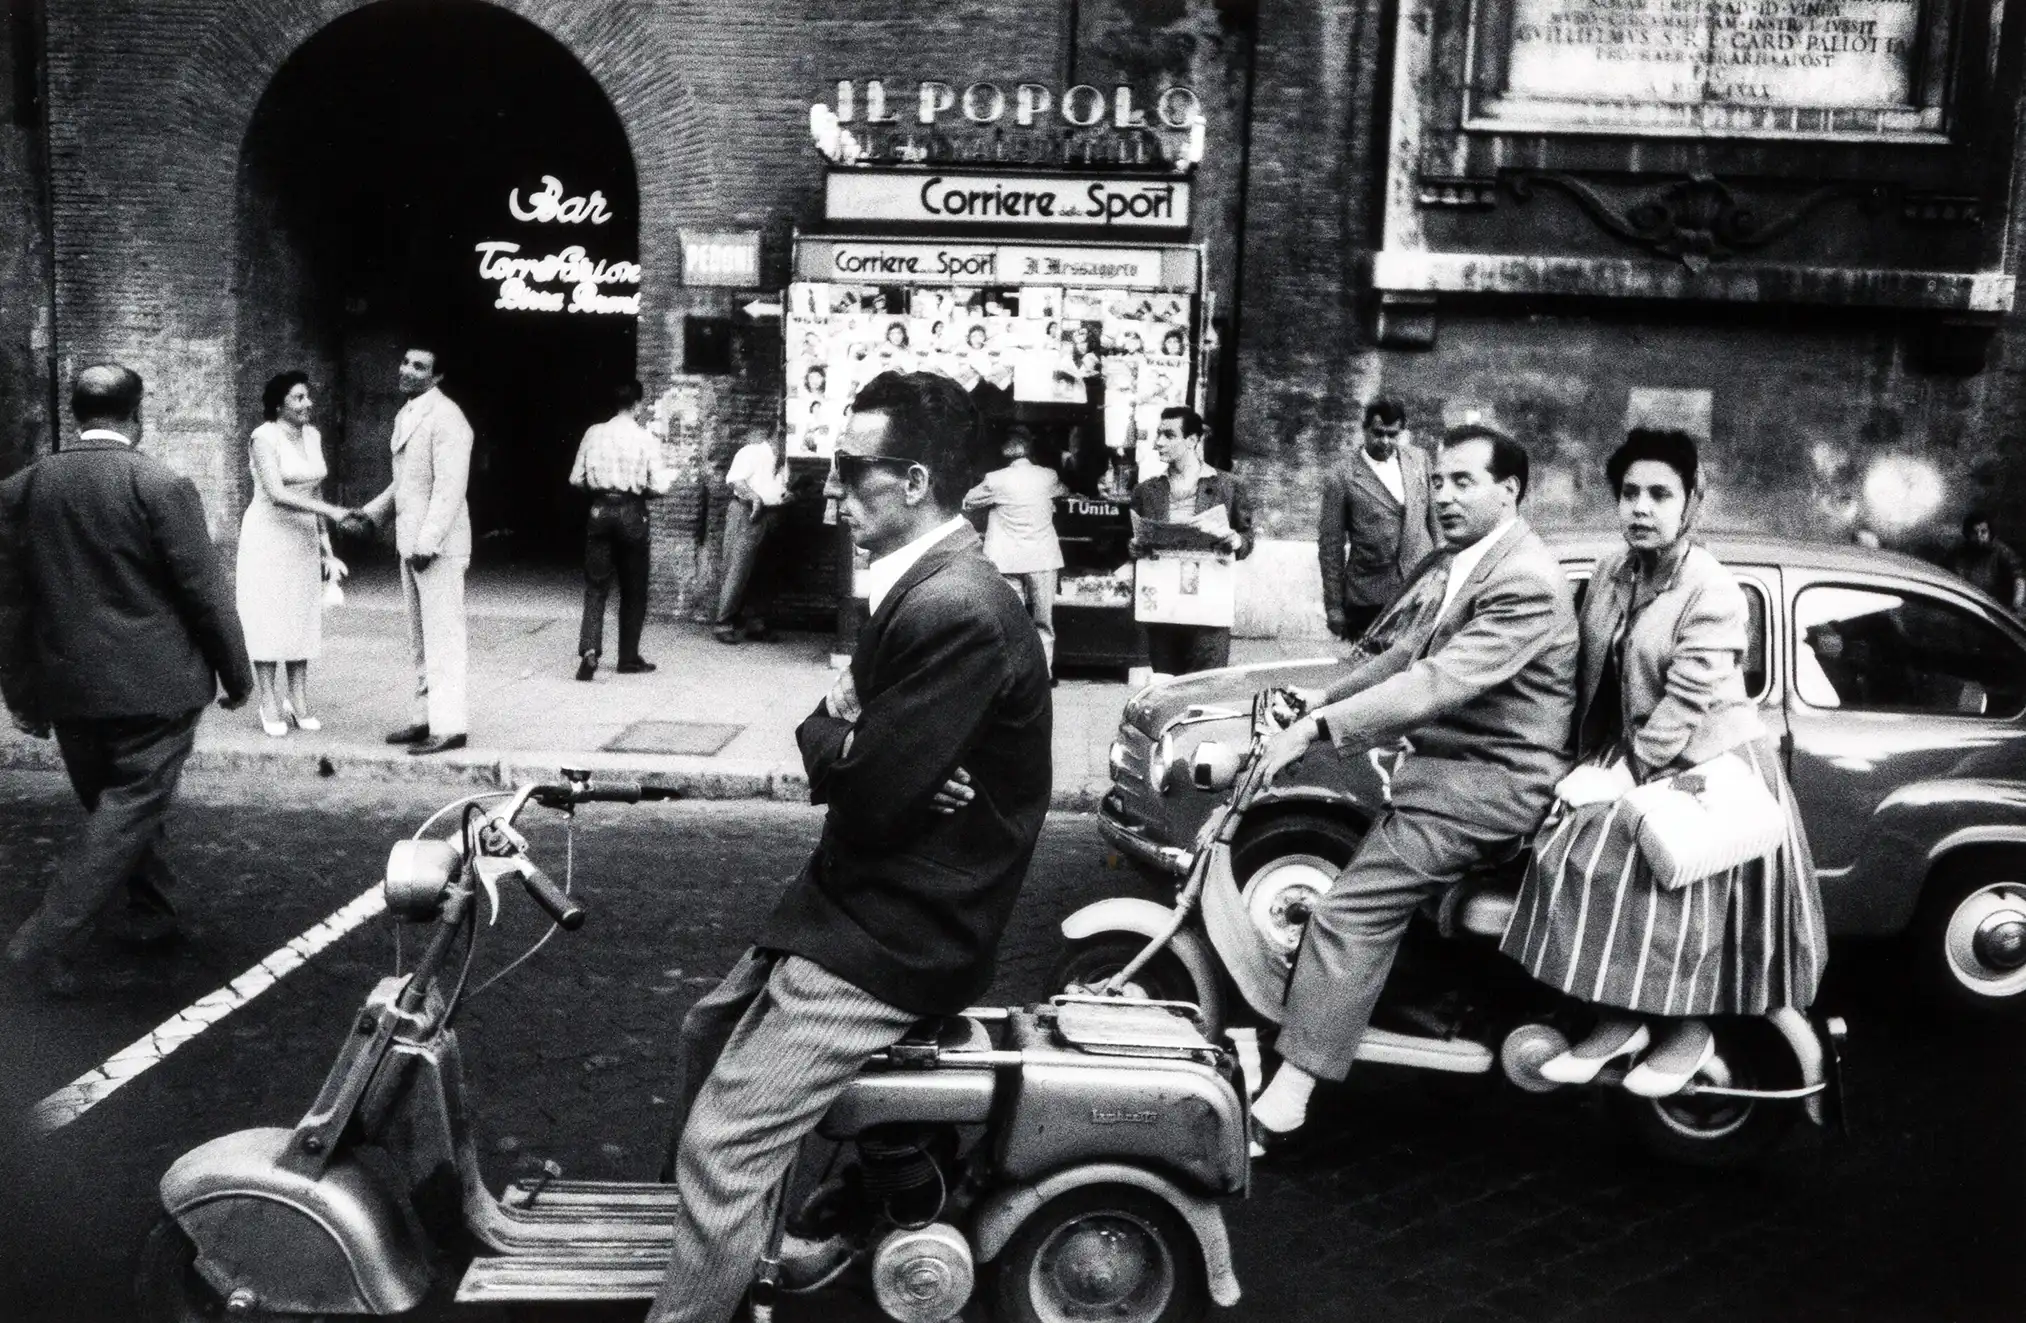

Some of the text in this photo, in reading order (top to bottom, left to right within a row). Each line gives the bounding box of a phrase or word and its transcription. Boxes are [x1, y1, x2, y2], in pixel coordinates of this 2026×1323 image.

[836, 79, 1201, 129] IL POPOLO
[508, 174, 613, 224] Bar
[919, 176, 1056, 217] Corriere
[1085, 181, 1174, 224] Sport
[835, 249, 997, 277] Corriere Sport
